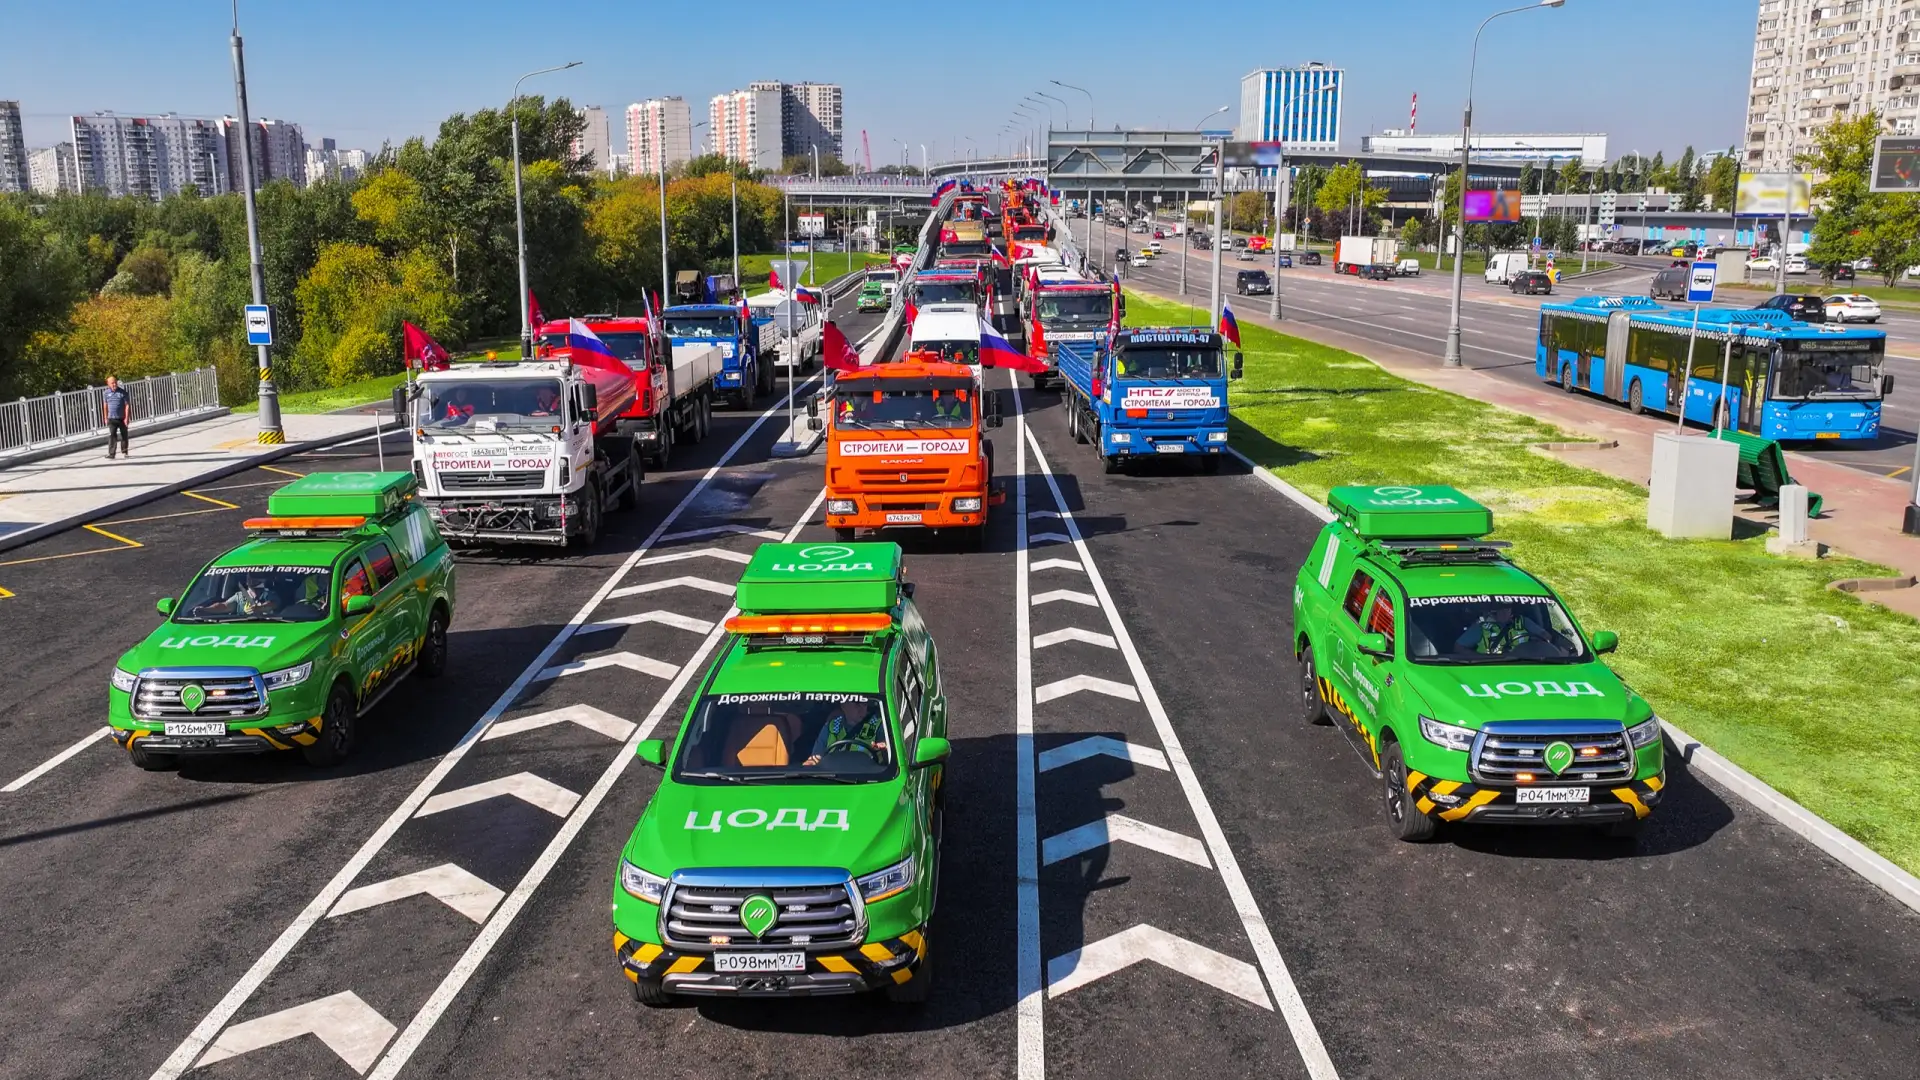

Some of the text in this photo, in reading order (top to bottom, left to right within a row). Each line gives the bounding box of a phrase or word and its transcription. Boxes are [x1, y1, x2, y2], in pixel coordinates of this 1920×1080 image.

[1131, 333, 1210, 343] МОСТООТРЯД-47
[1124, 399, 1171, 407] СТРОИТЕЛИ
[1183, 399, 1217, 407] ГОРОДУ
[843, 443, 903, 453] СТРОИТЕЛИ
[921, 442, 965, 452] ГОРОДУ
[432, 460, 491, 469] СТРОИТЕЛИ
[508, 459, 551, 469] ГОРОДУ
[204, 565, 330, 576] Дорожный патруль
[772, 562, 873, 572] ЦОДД
[1409, 594, 1491, 608] Дорожный
[1495, 594, 1556, 607] патруль
[160, 636, 276, 649] ЦОДД
[1461, 681, 1605, 699] ЦОДД
[717, 692, 868, 705] Дорожный патруль
[684, 808, 849, 833] ЦОДД
